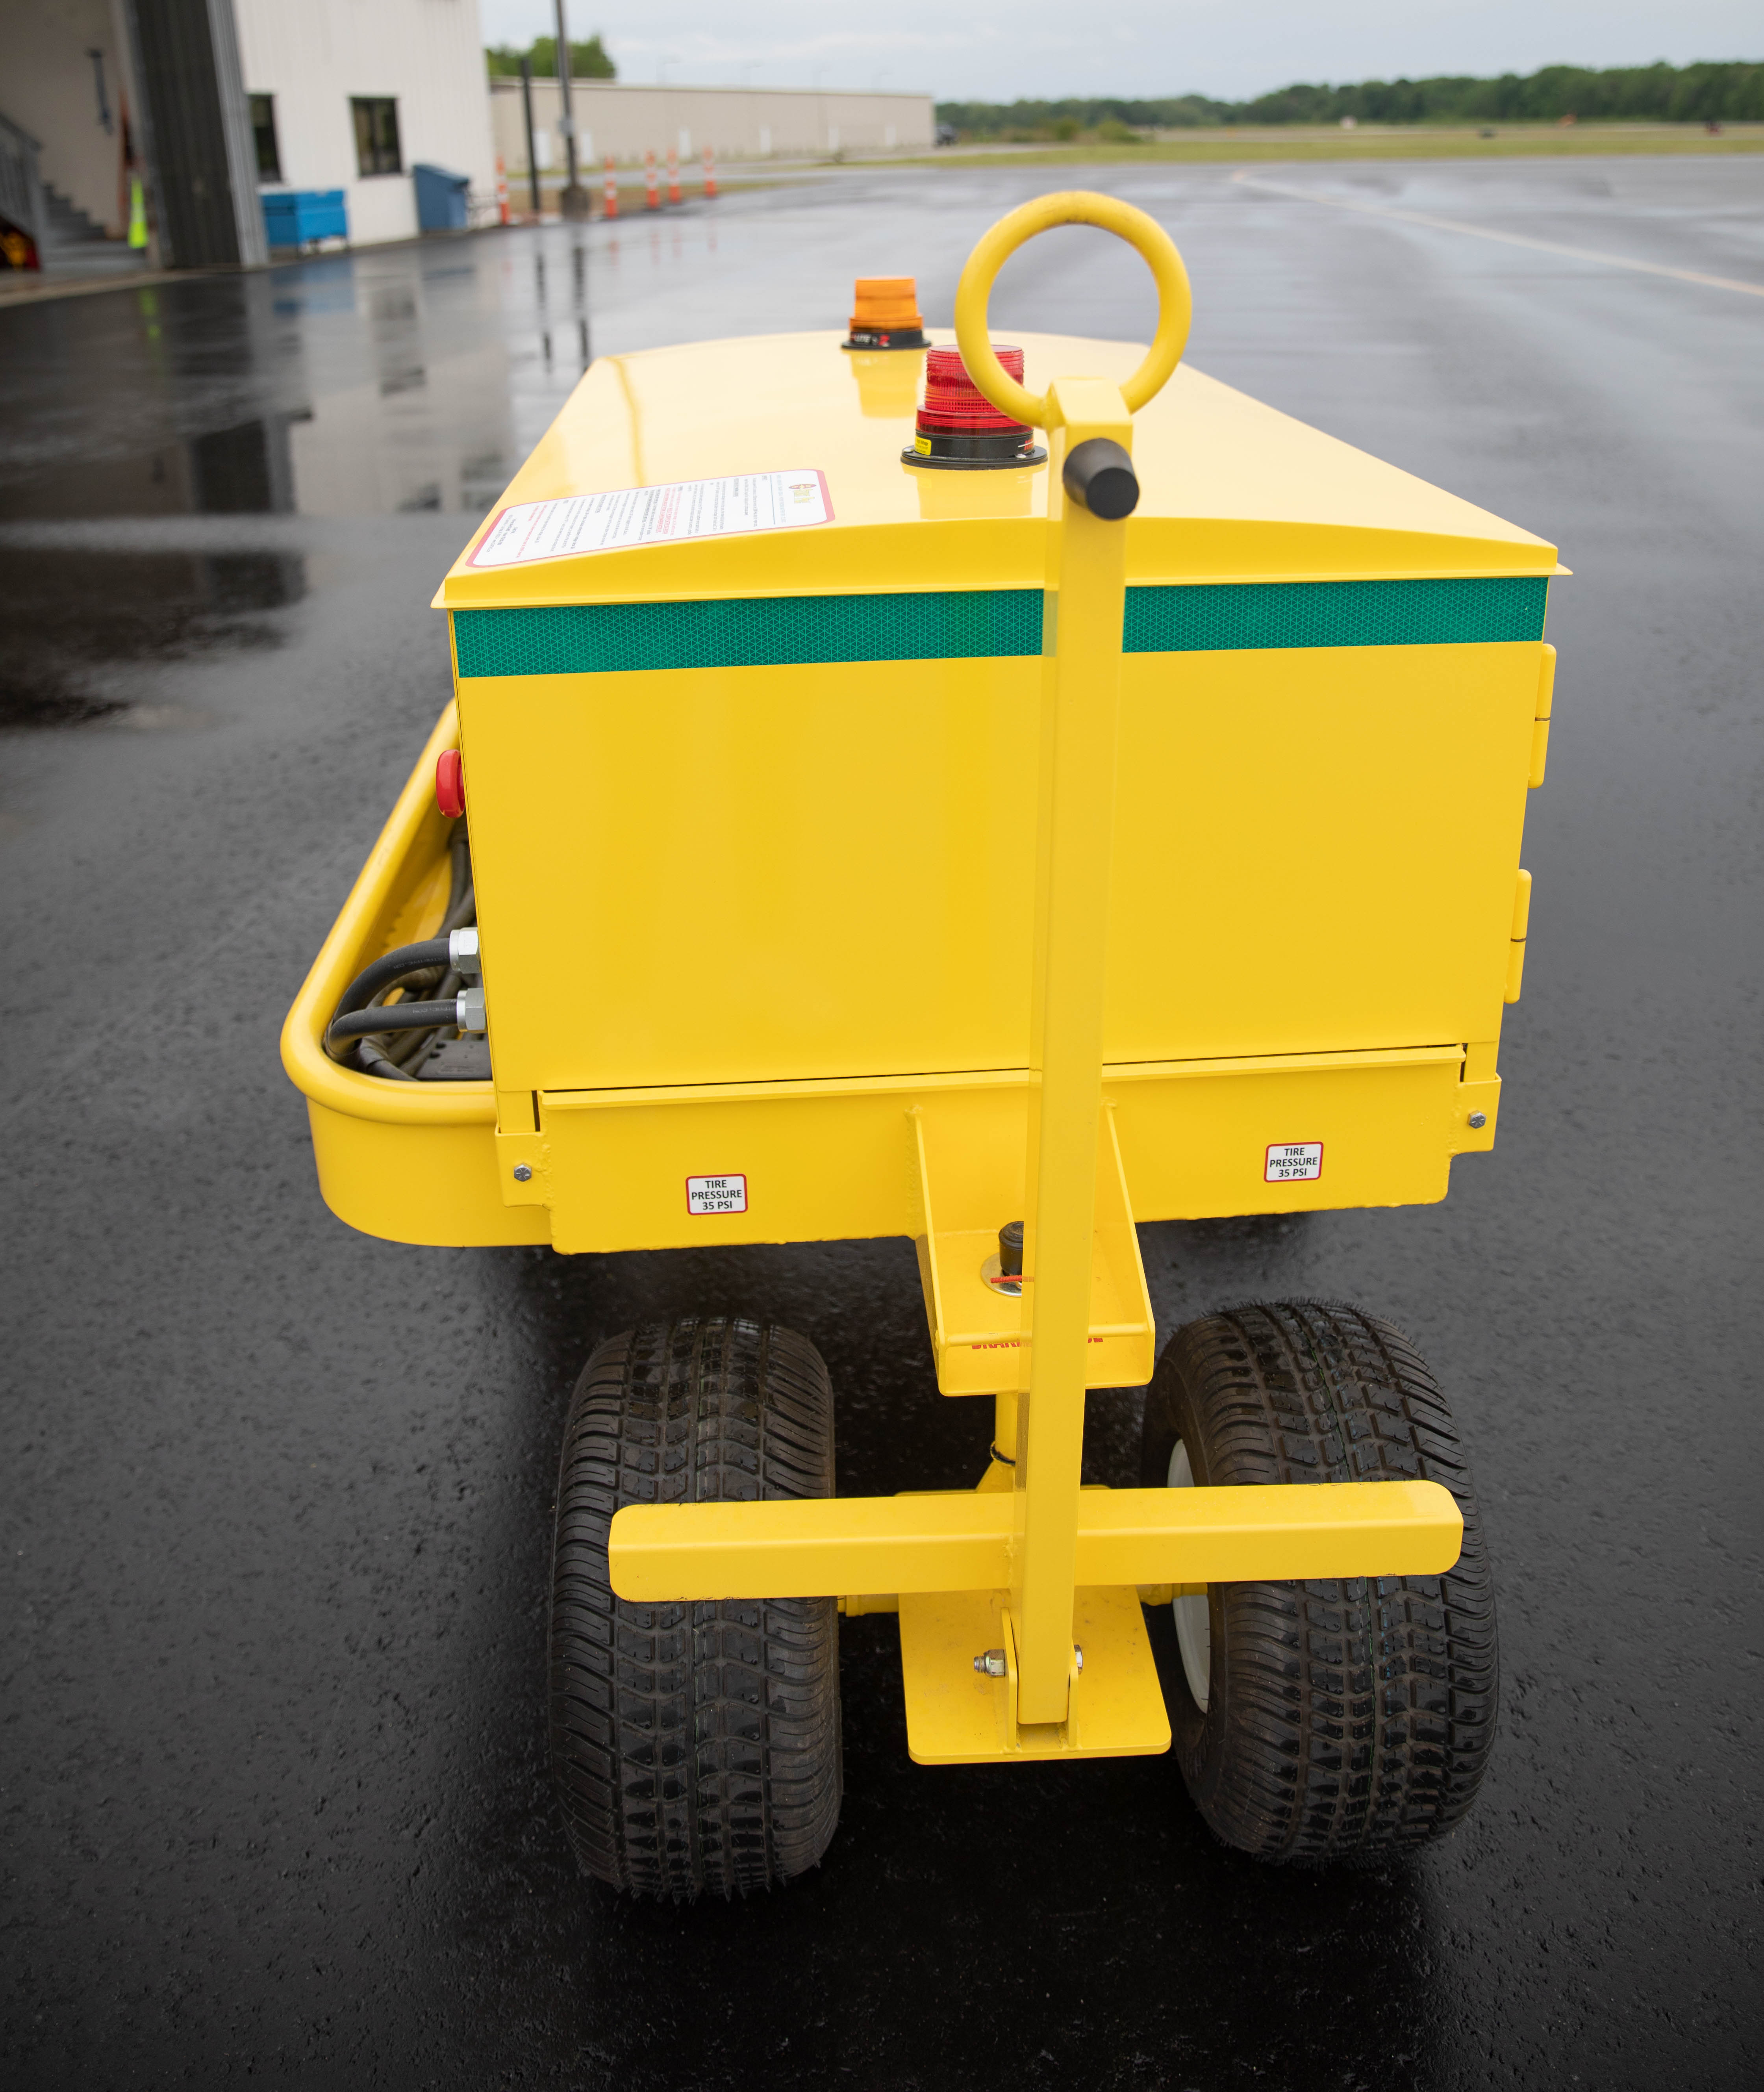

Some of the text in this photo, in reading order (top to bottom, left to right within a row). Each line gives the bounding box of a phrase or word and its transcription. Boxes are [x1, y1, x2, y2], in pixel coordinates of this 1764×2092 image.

[1284, 1148, 1304, 1156] TIRE
[1270, 1157, 1317, 1167] PRESSURE
[705, 1180, 726, 1188] TIRE
[692, 1190, 742, 1200] PRESSURE
